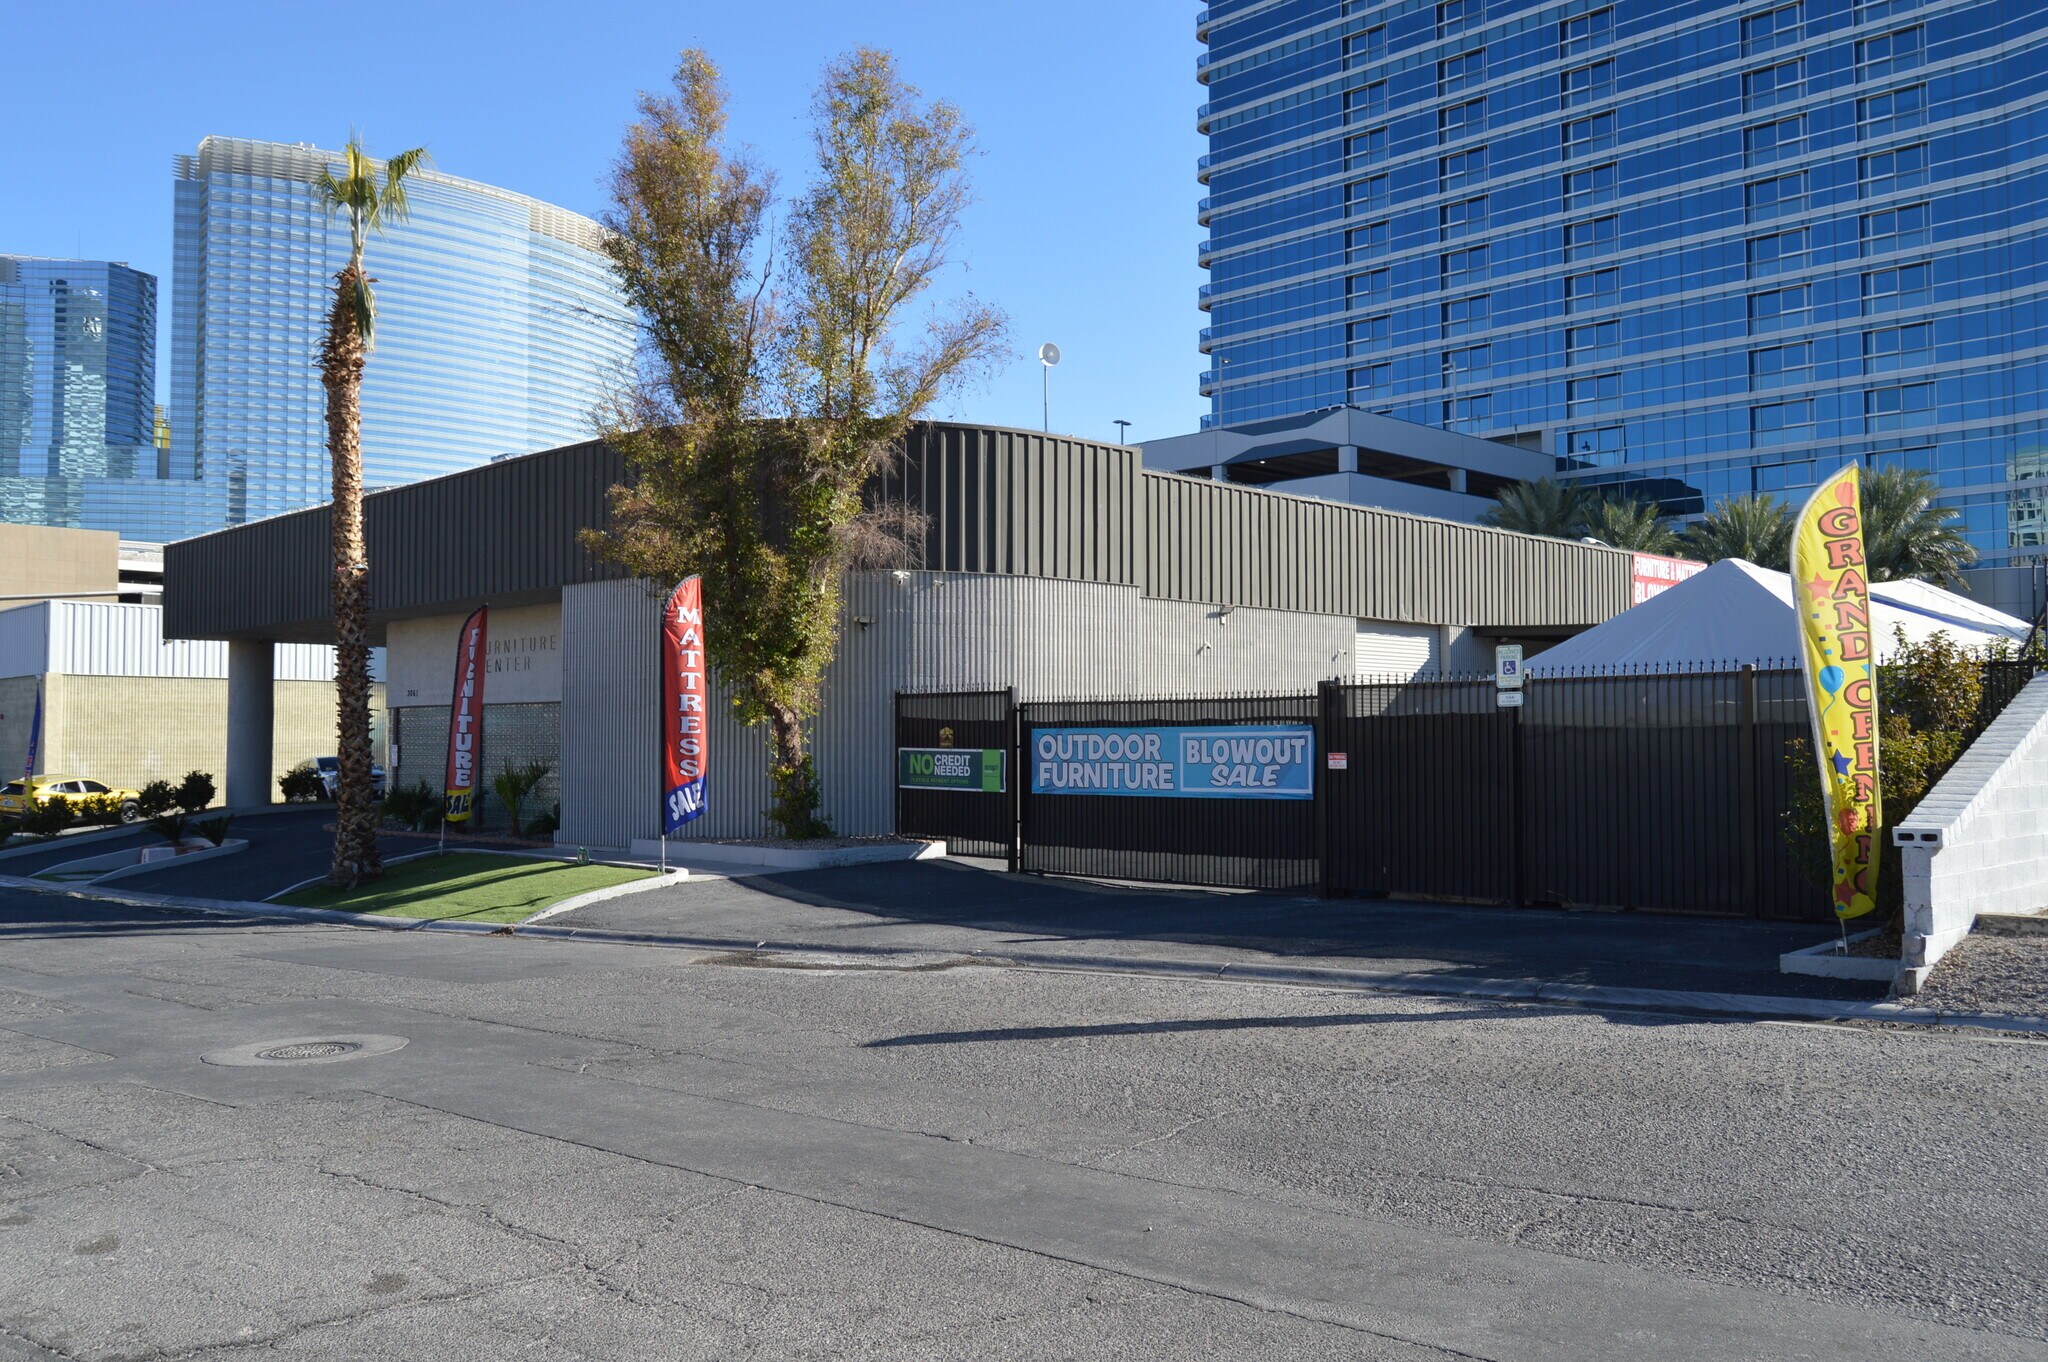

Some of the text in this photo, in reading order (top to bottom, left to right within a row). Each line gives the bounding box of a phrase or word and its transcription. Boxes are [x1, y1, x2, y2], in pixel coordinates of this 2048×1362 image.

[1634, 556, 1670, 580] FURNITURE
[1818, 506, 1870, 662] GRAND
[486, 634, 557, 655] URNITURE
[486, 656, 531, 674] ENTER
[677, 606, 702, 777] MATTRESS
[1038, 733, 1162, 761] OUTDOOR
[1185, 738, 1306, 765] BLOWOUT
[909, 754, 934, 775] NO
[934, 754, 971, 766] CREDIT
[934, 766, 971, 776] NEEDED
[1038, 761, 1175, 790] FURNITURE
[1210, 764, 1281, 787] SALE
[669, 782, 704, 821] SALE
